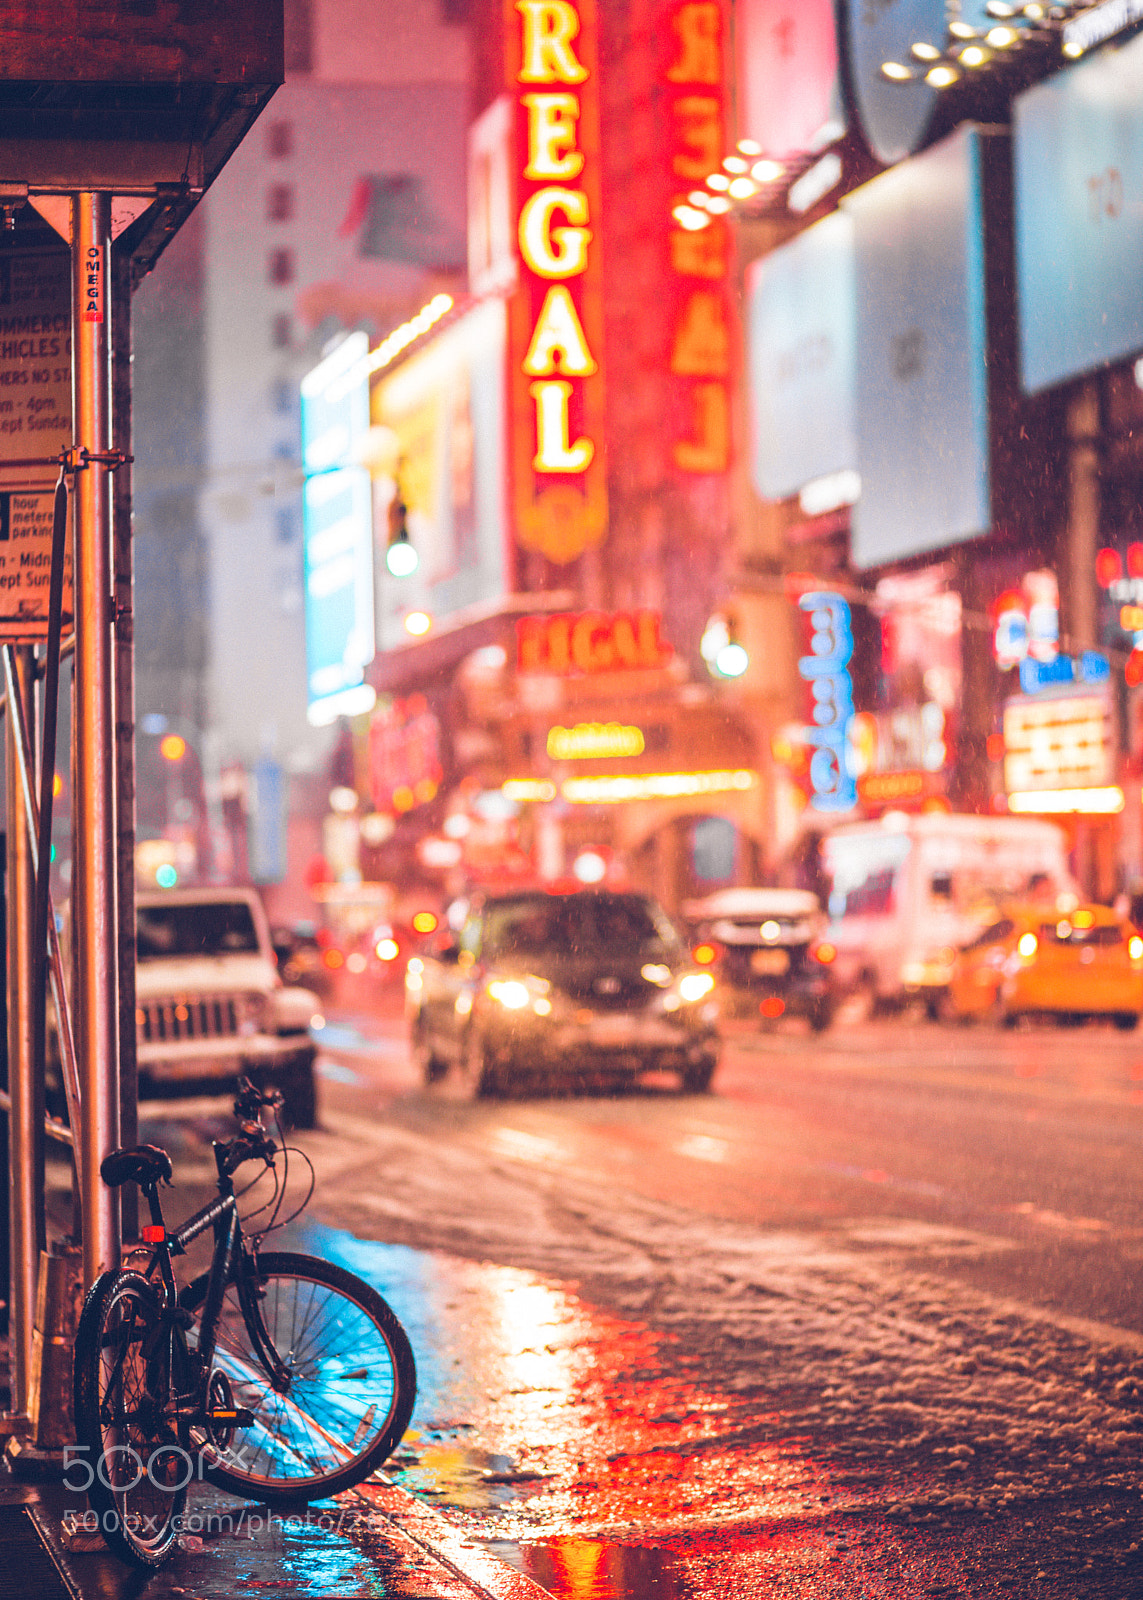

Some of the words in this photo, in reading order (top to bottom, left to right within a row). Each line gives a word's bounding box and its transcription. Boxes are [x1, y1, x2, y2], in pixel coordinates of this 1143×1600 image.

[517, 0, 598, 473] REGAL
[86, 248, 100, 311] OMEGA
[0, 313, 71, 335] MMERCI
[0, 338, 60, 359] HICLES
[32, 369, 49, 383] NO
[54, 367, 71, 383] ST
[27, 396, 55, 413] 4pm
[13, 498, 38, 509] hour
[13, 511, 54, 523] metere
[27, 571, 73, 590] Suny
